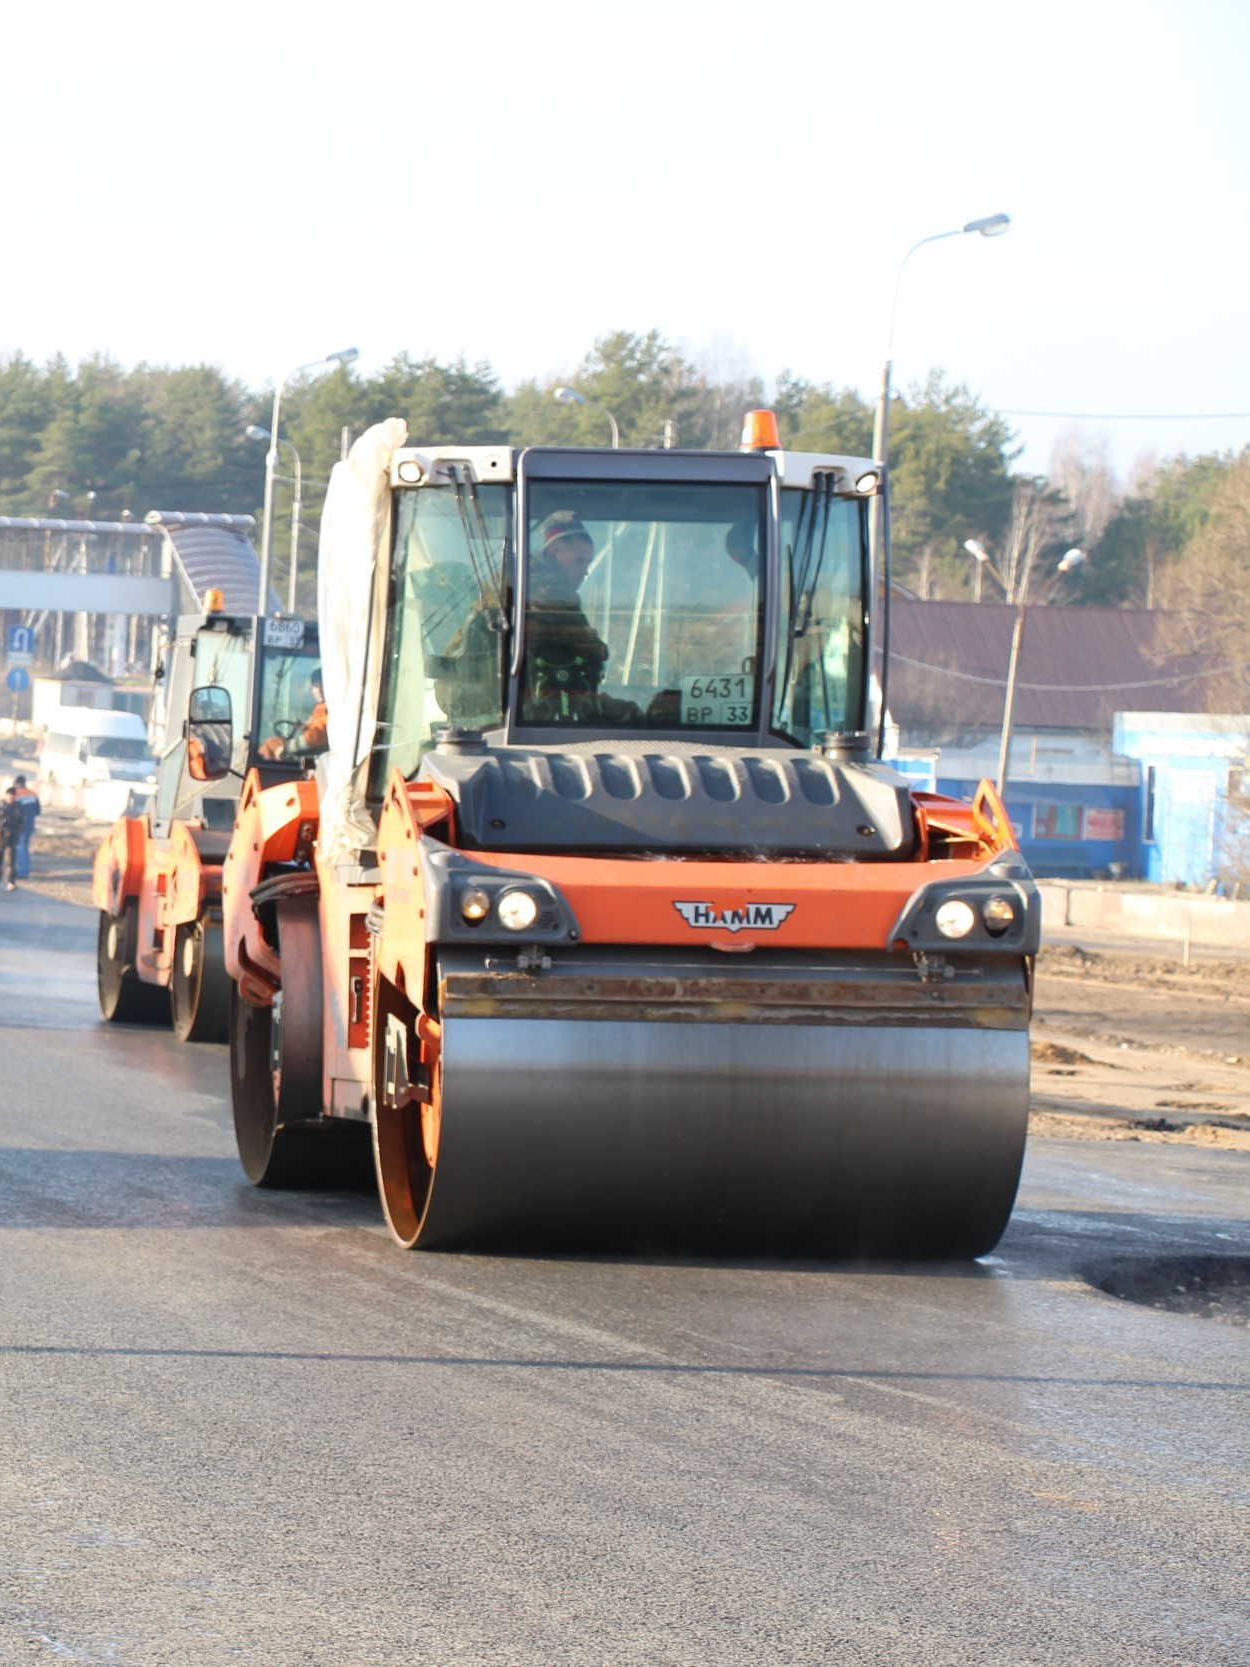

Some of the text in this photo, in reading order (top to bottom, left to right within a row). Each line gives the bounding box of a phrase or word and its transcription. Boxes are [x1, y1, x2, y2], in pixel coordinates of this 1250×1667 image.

[270, 620, 300, 633] 6860
[690, 678, 746, 699] 6431
[687, 706, 749, 723] ВР 33
[694, 905, 774, 925] HAMM
